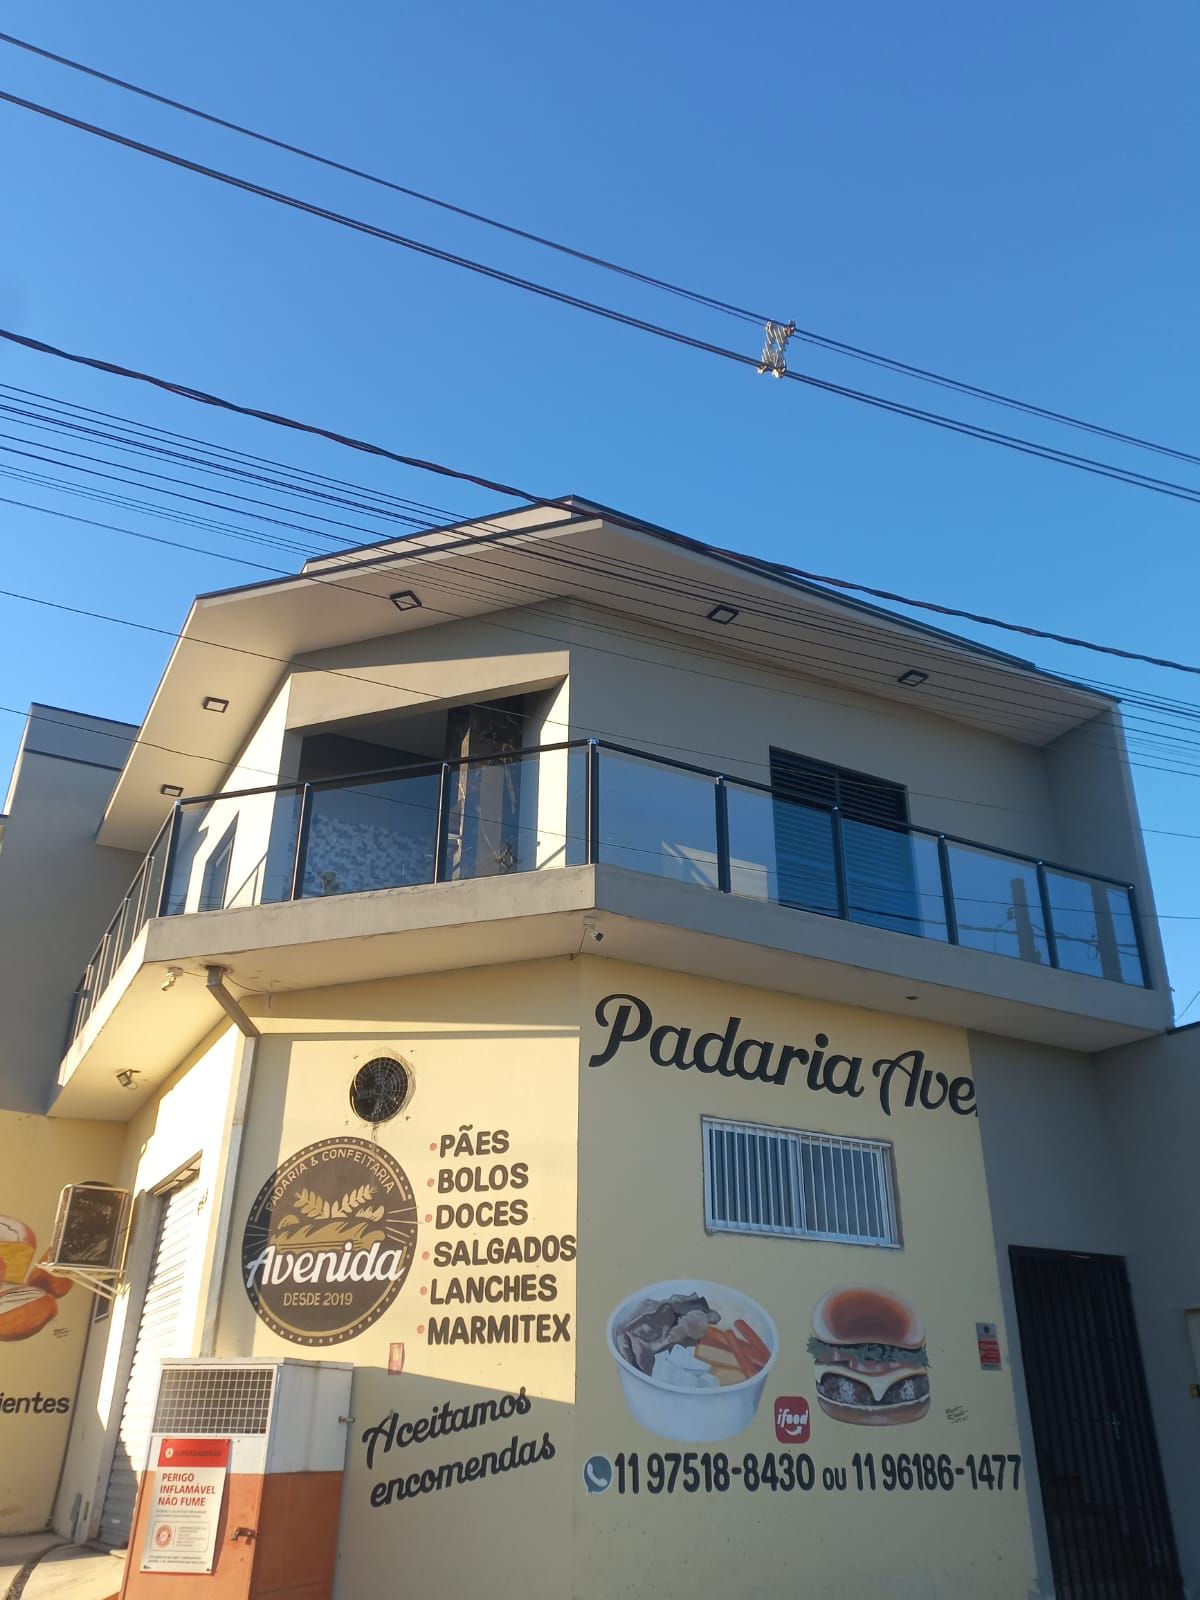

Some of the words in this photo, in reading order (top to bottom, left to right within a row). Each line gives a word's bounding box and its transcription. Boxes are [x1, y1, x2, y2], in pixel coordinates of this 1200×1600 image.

[588, 993, 865, 1098] Padaria
[872, 1050, 978, 1117] Ave
[439, 1124, 510, 1158] PÃES
[265, 1164, 309, 1211] PADARIA
[310, 1157, 319, 1167] &
[321, 1149, 396, 1194] CONFEITARIA
[437, 1162, 529, 1194] BOLOS
[435, 1199, 529, 1229] DOCES
[245, 1241, 406, 1289] Avenida
[433, 1234, 577, 1267] SALGADOS
[283, 1292, 320, 1307] DESDE
[322, 1292, 353, 1306] 2019
[430, 1273, 558, 1305] LANCHES
[427, 1313, 571, 1345] MARMITEX
[361, 1386, 532, 1470] Aceitamos
[162, 1473, 195, 1482] PERIGO
[370, 1431, 556, 1508] encomendas
[614, 1452, 640, 1494] 11
[647, 1452, 815, 1493] 97518-8430
[822, 1467, 847, 1490] ou
[852, 1453, 876, 1491] 11
[881, 1453, 1021, 1491] 96186-1477
[157, 1494, 178, 1506] NÃO
[180, 1497, 206, 1506] FUME
[160, 1483, 216, 1494] INFLAMÁVEL
